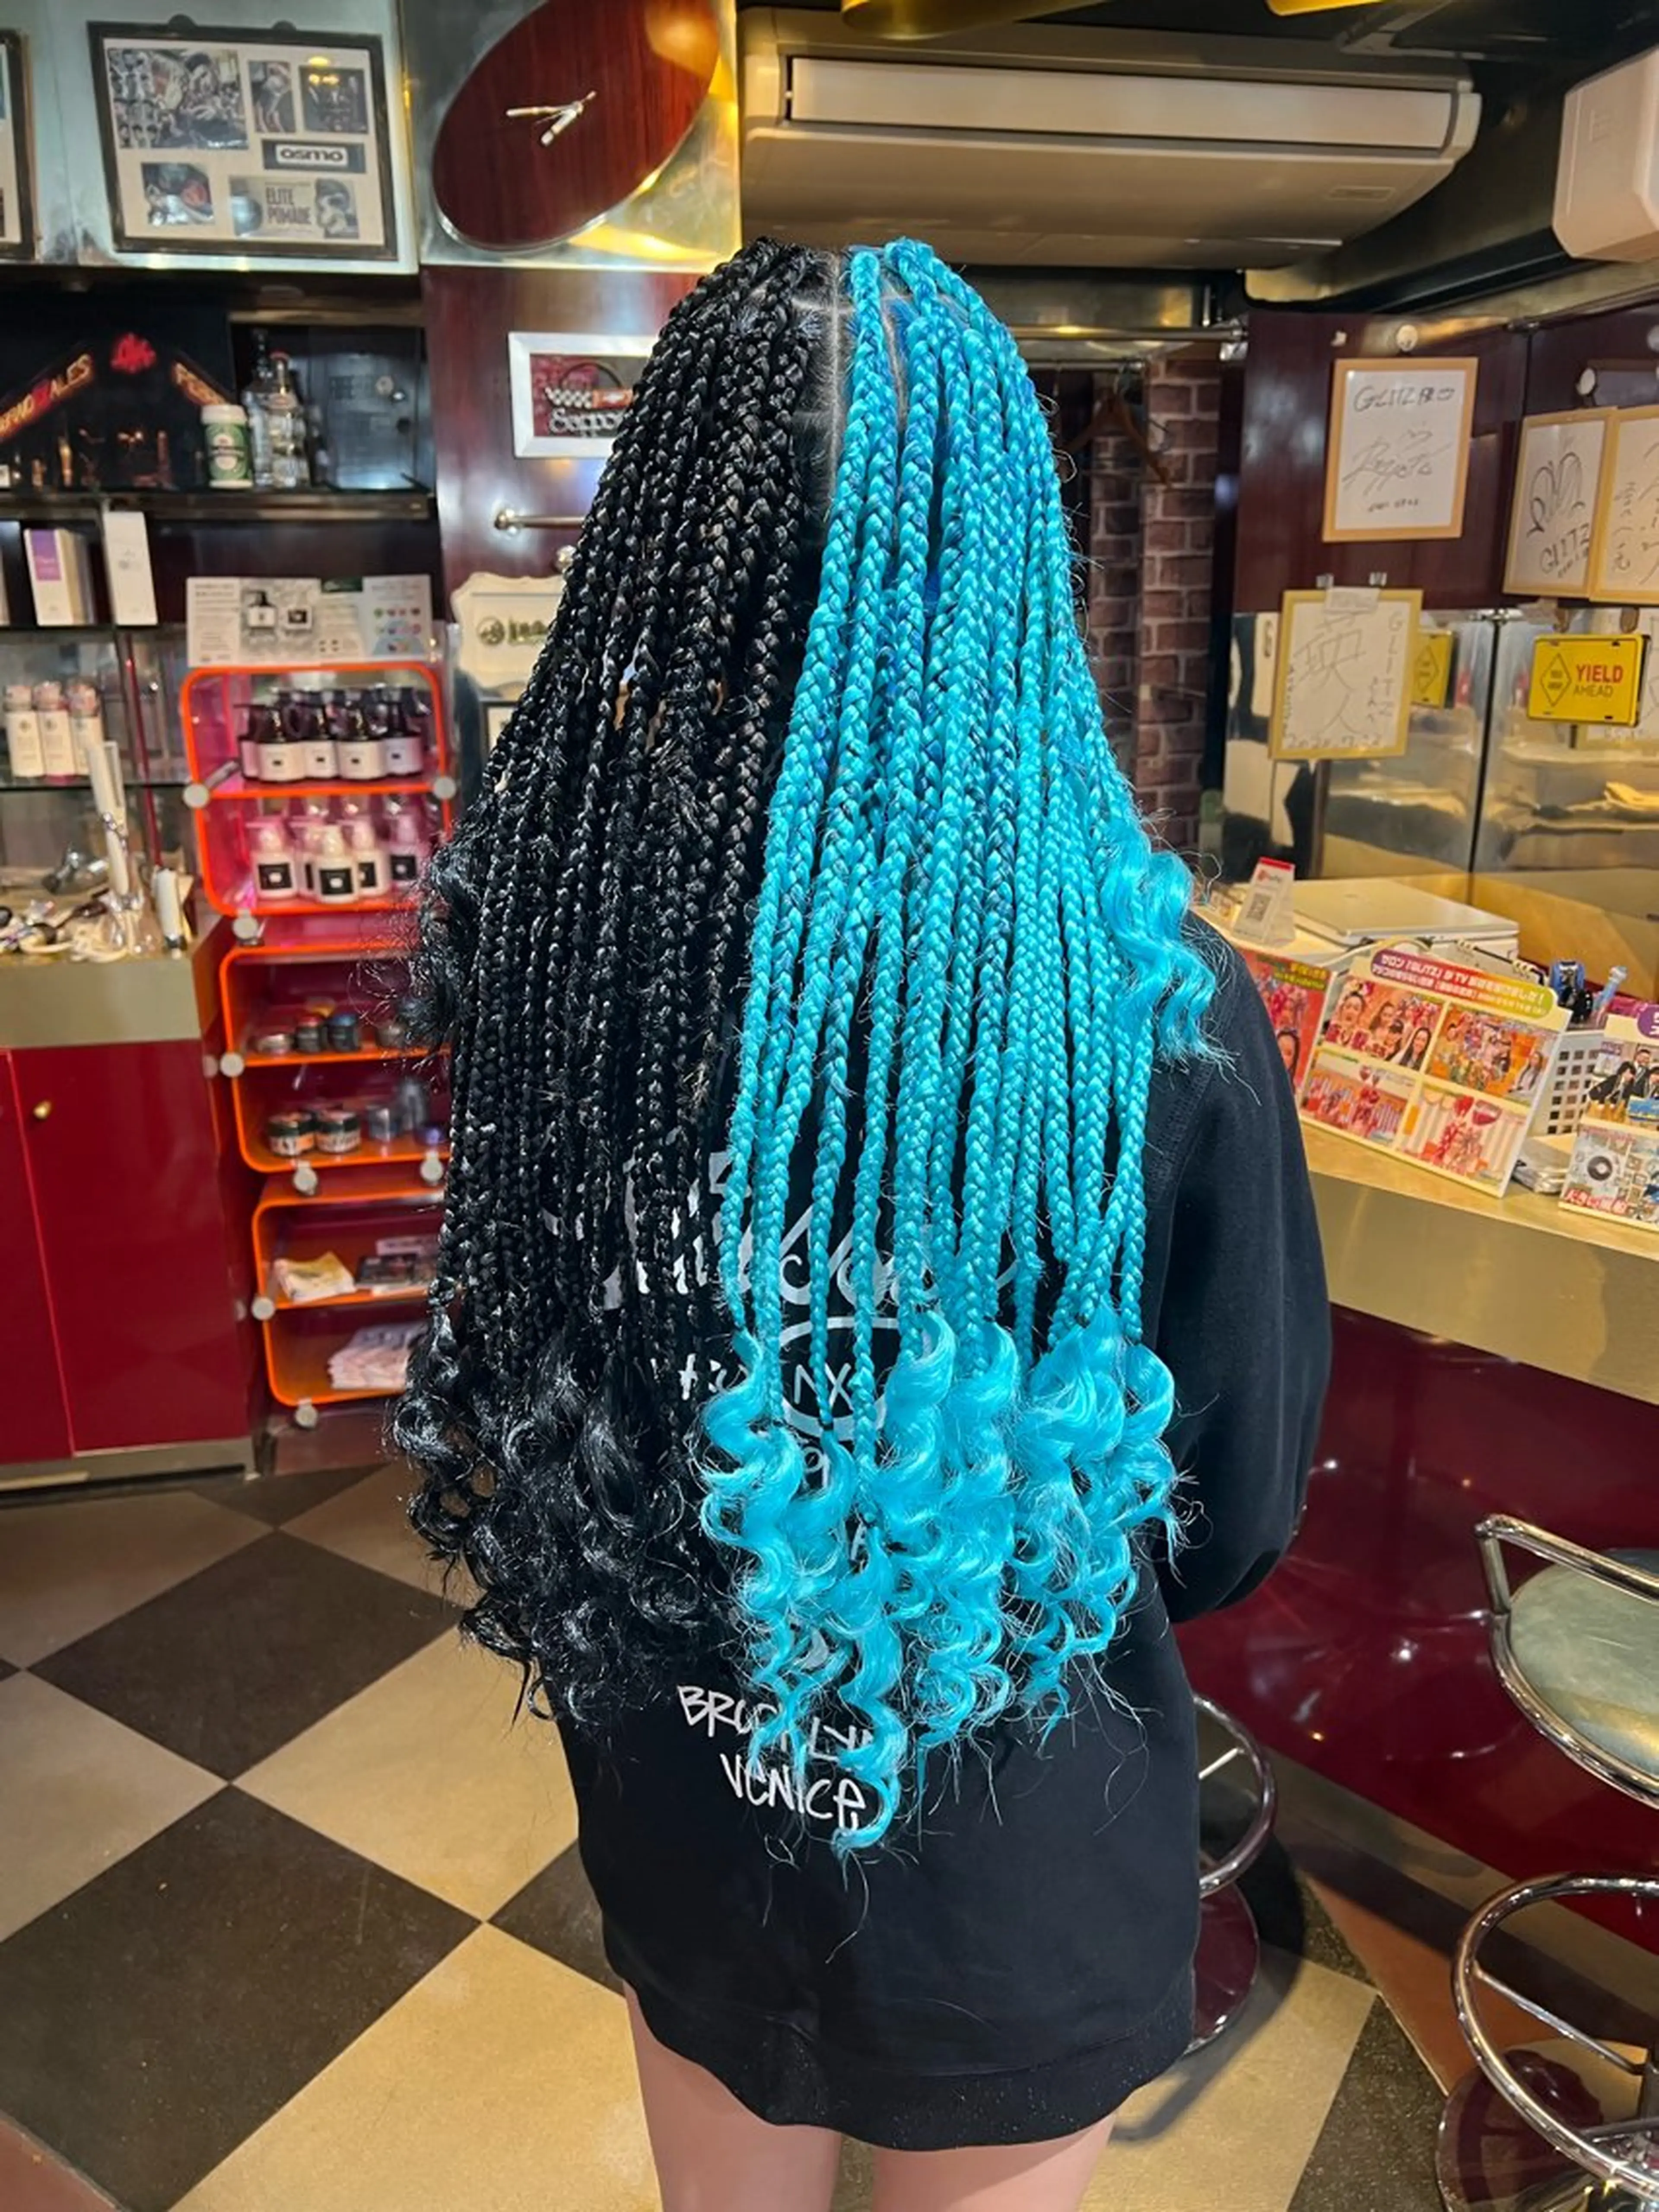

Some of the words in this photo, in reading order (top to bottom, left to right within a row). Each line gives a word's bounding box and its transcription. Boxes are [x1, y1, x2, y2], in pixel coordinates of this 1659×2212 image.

[280, 148, 344, 162] osmo
[1576, 664, 1623, 683] YIELD
[1573, 685, 1614, 698] AHEAD
